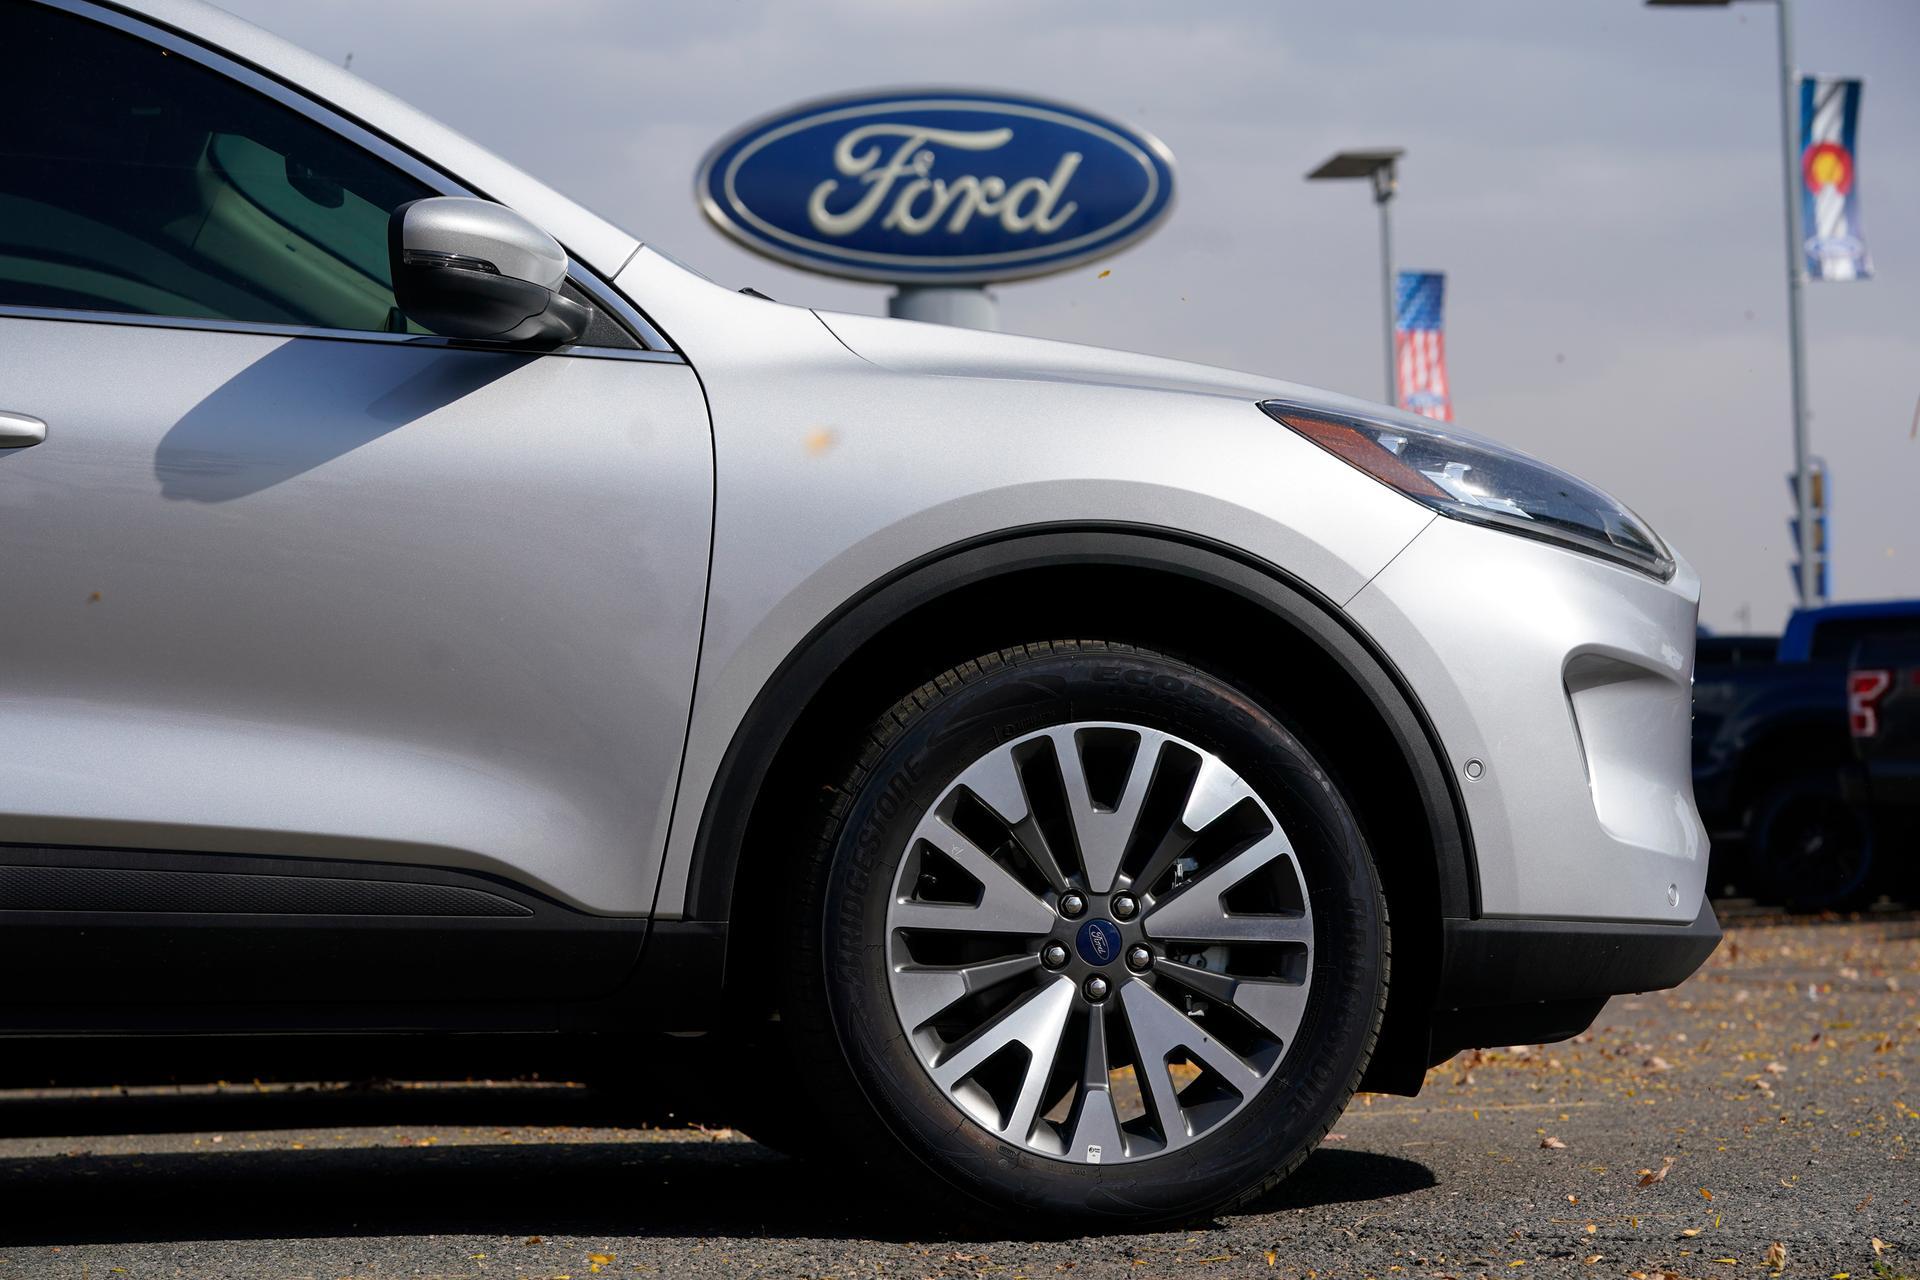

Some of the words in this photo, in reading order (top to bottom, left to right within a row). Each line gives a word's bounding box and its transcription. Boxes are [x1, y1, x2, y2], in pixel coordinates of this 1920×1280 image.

[808, 122, 1083, 236] Ford
[833, 753, 928, 988] BRIDGESTONE
[1091, 931, 1106, 954] Ford
